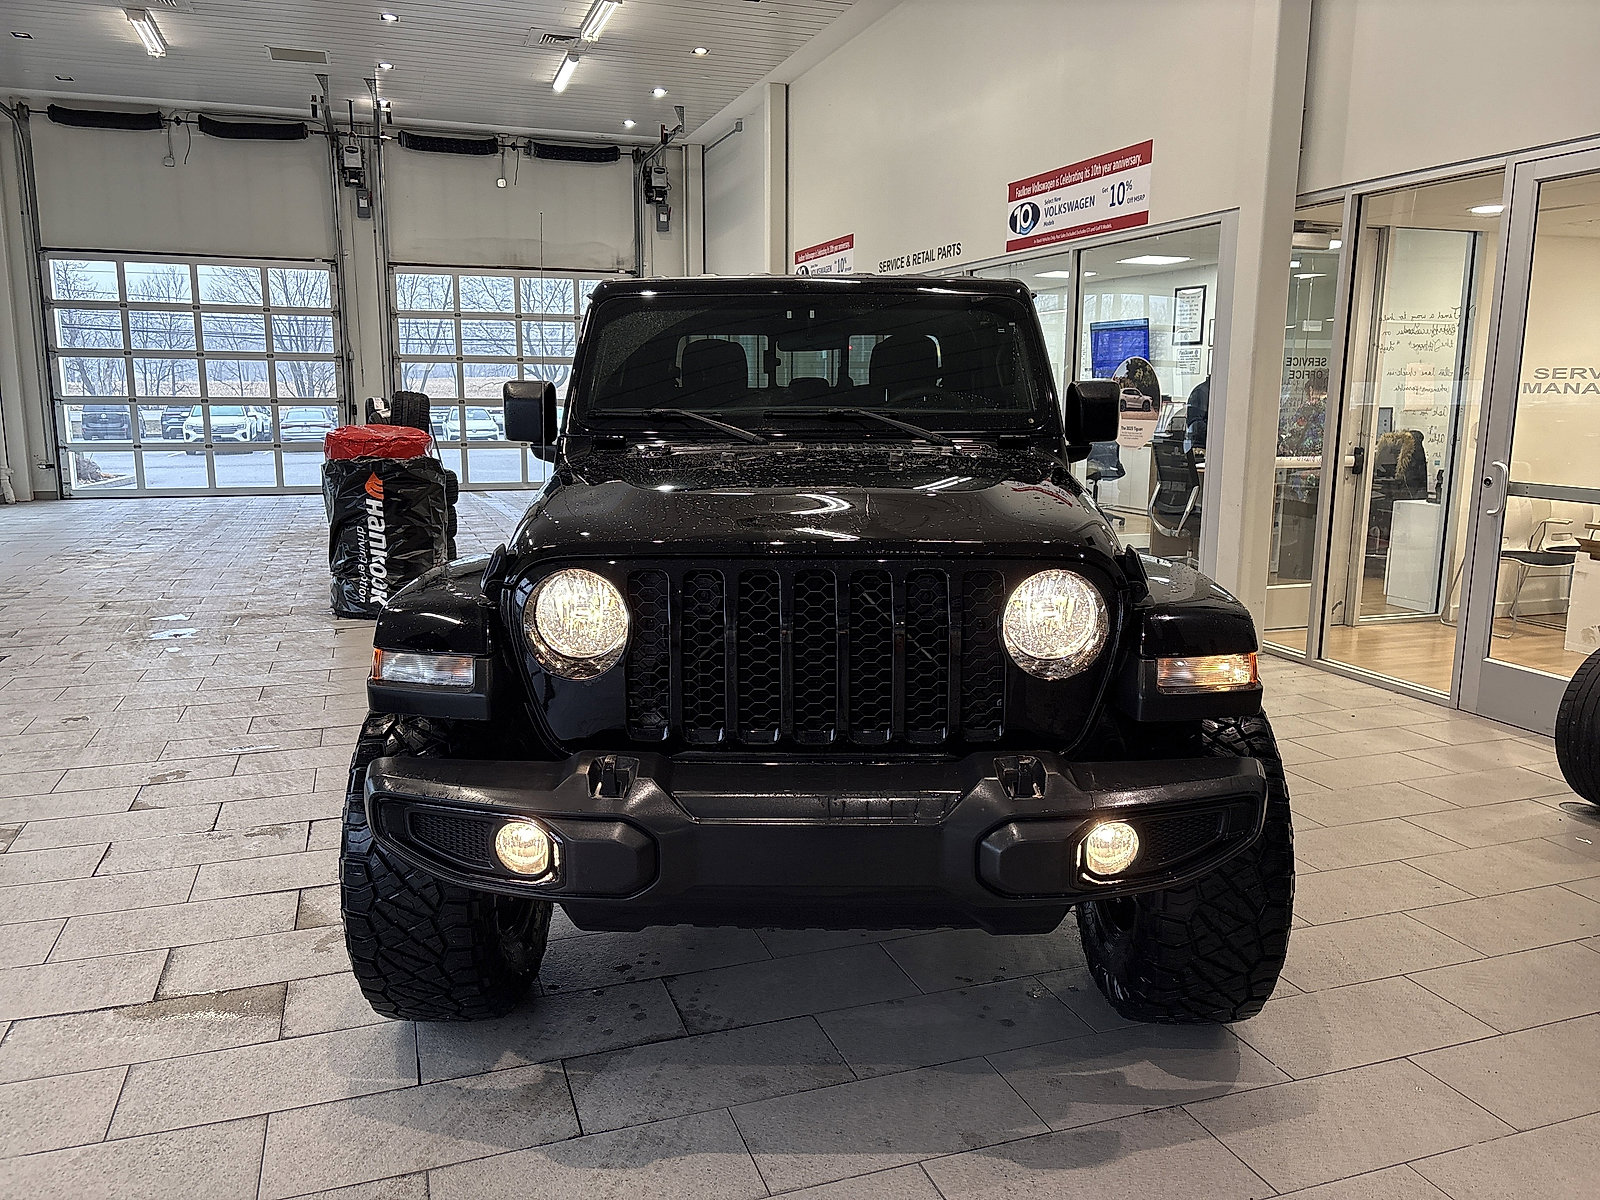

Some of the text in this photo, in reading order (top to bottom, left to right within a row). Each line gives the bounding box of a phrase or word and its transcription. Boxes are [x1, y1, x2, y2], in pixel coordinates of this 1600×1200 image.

[1015, 185, 1032, 198] Faulkner
[1032, 180, 1055, 193] Volkswagen
[1056, 175, 1060, 186] is
[1060, 169, 1083, 186] Celebrating
[1091, 163, 1101, 177] 10th
[1102, 162, 1112, 177] year
[1014, 203, 1032, 233] 10
[1044, 195, 1095, 218] VOLKSWAGEN
[878, 242, 962, 273] SERVICE & RETAIL PARTS
[1522, 382, 1600, 395] MANA
[357, 526, 367, 564] driving
[365, 497, 388, 607] Hankook
